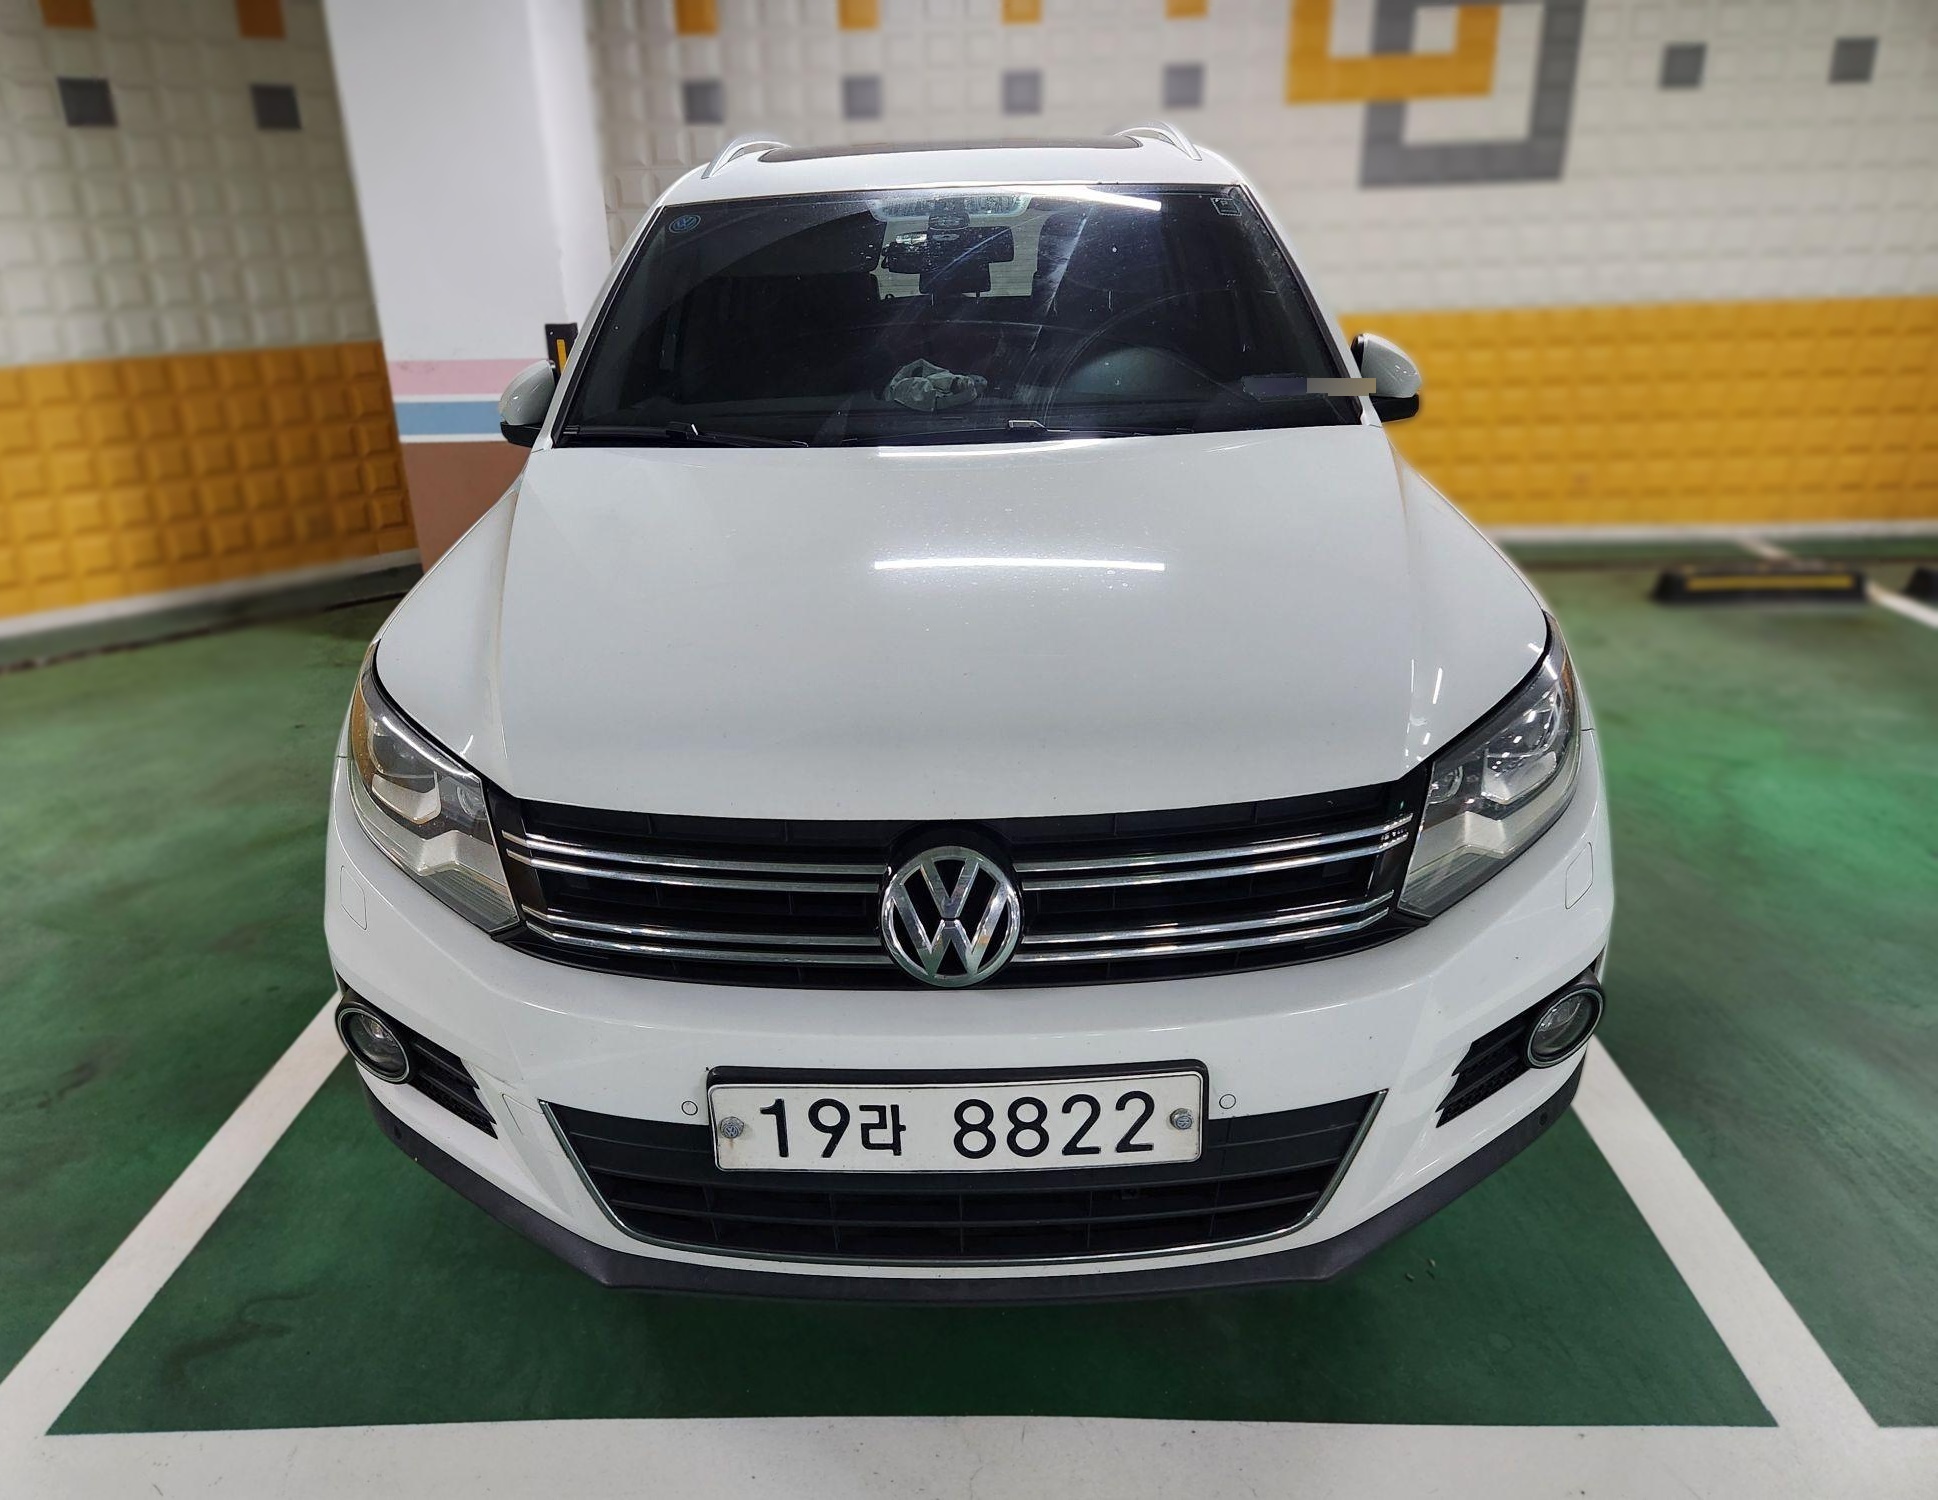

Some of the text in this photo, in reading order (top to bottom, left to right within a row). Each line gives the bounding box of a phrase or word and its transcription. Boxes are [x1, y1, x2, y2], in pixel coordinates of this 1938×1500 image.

[883, 847, 1019, 986] VW
[759, 1090, 1156, 1160] 19라 8822
